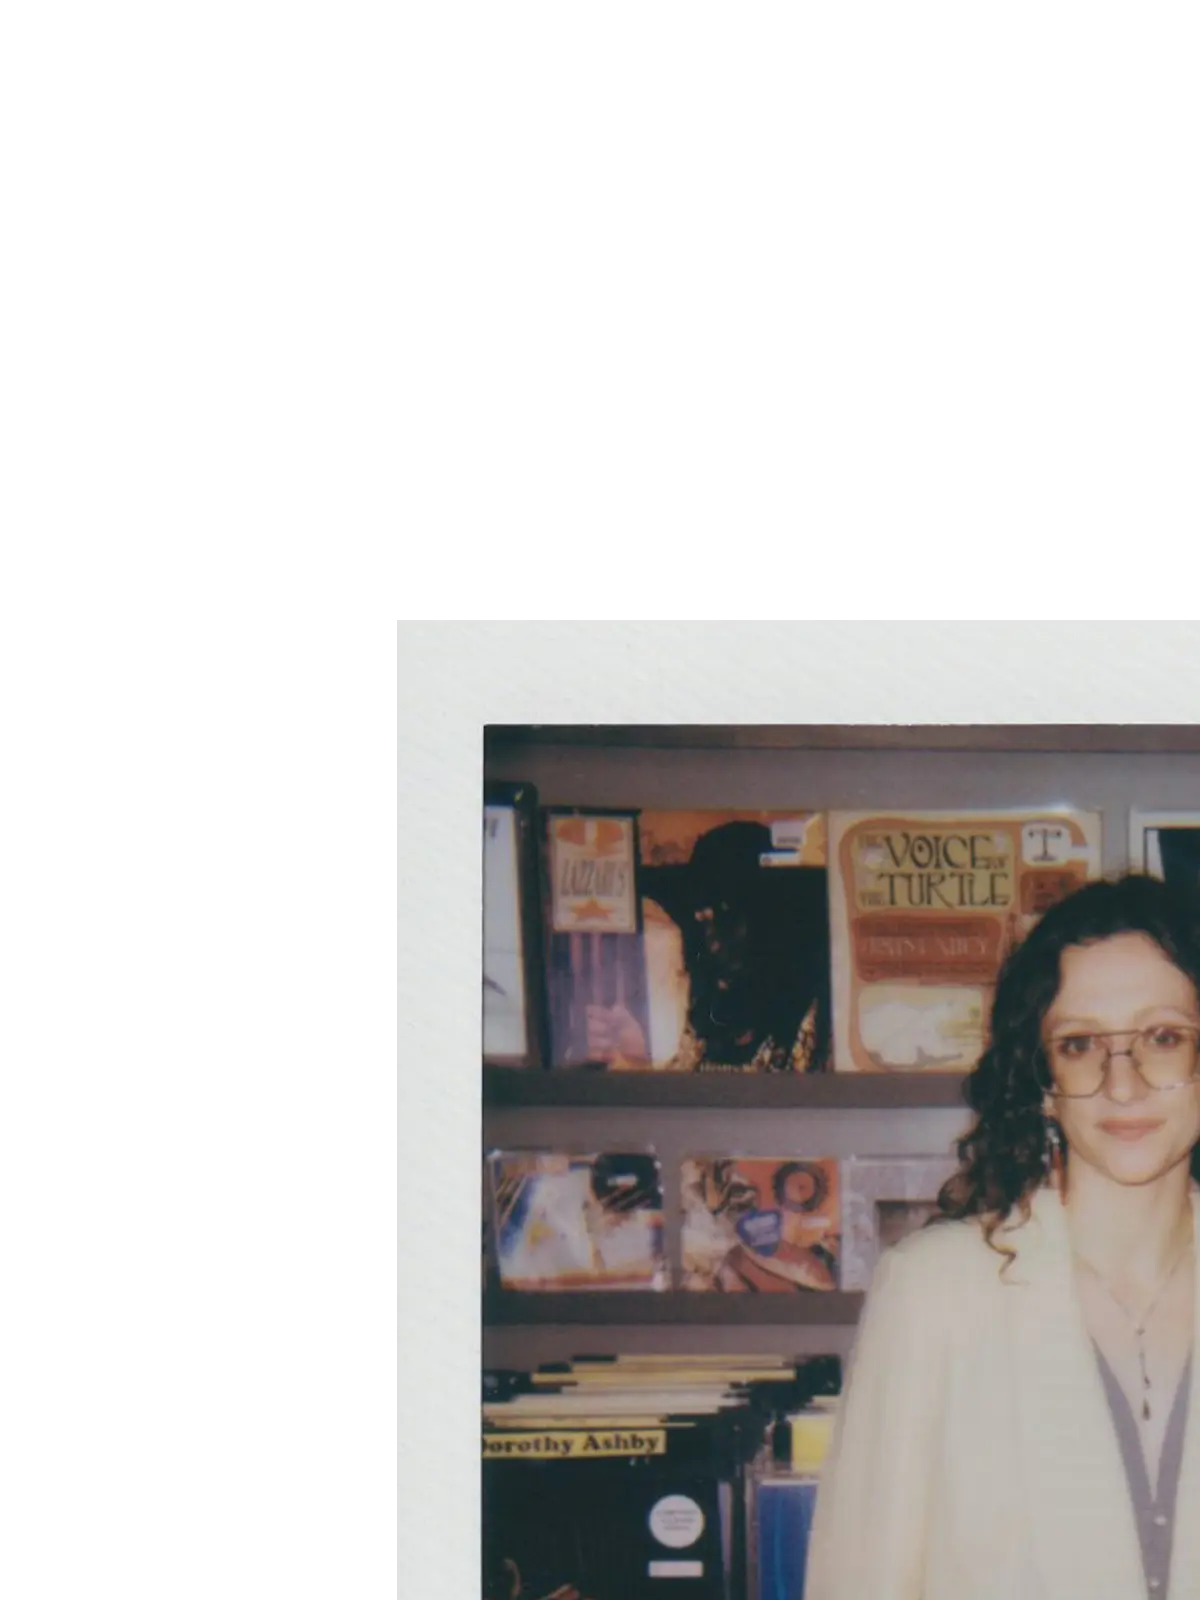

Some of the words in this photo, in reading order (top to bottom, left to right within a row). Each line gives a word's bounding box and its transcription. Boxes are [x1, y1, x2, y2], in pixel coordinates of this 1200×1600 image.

[883, 832, 992, 869] VOICE
[877, 871, 1011, 908] TURTLE
[583, 1433, 659, 1451] Ashby
